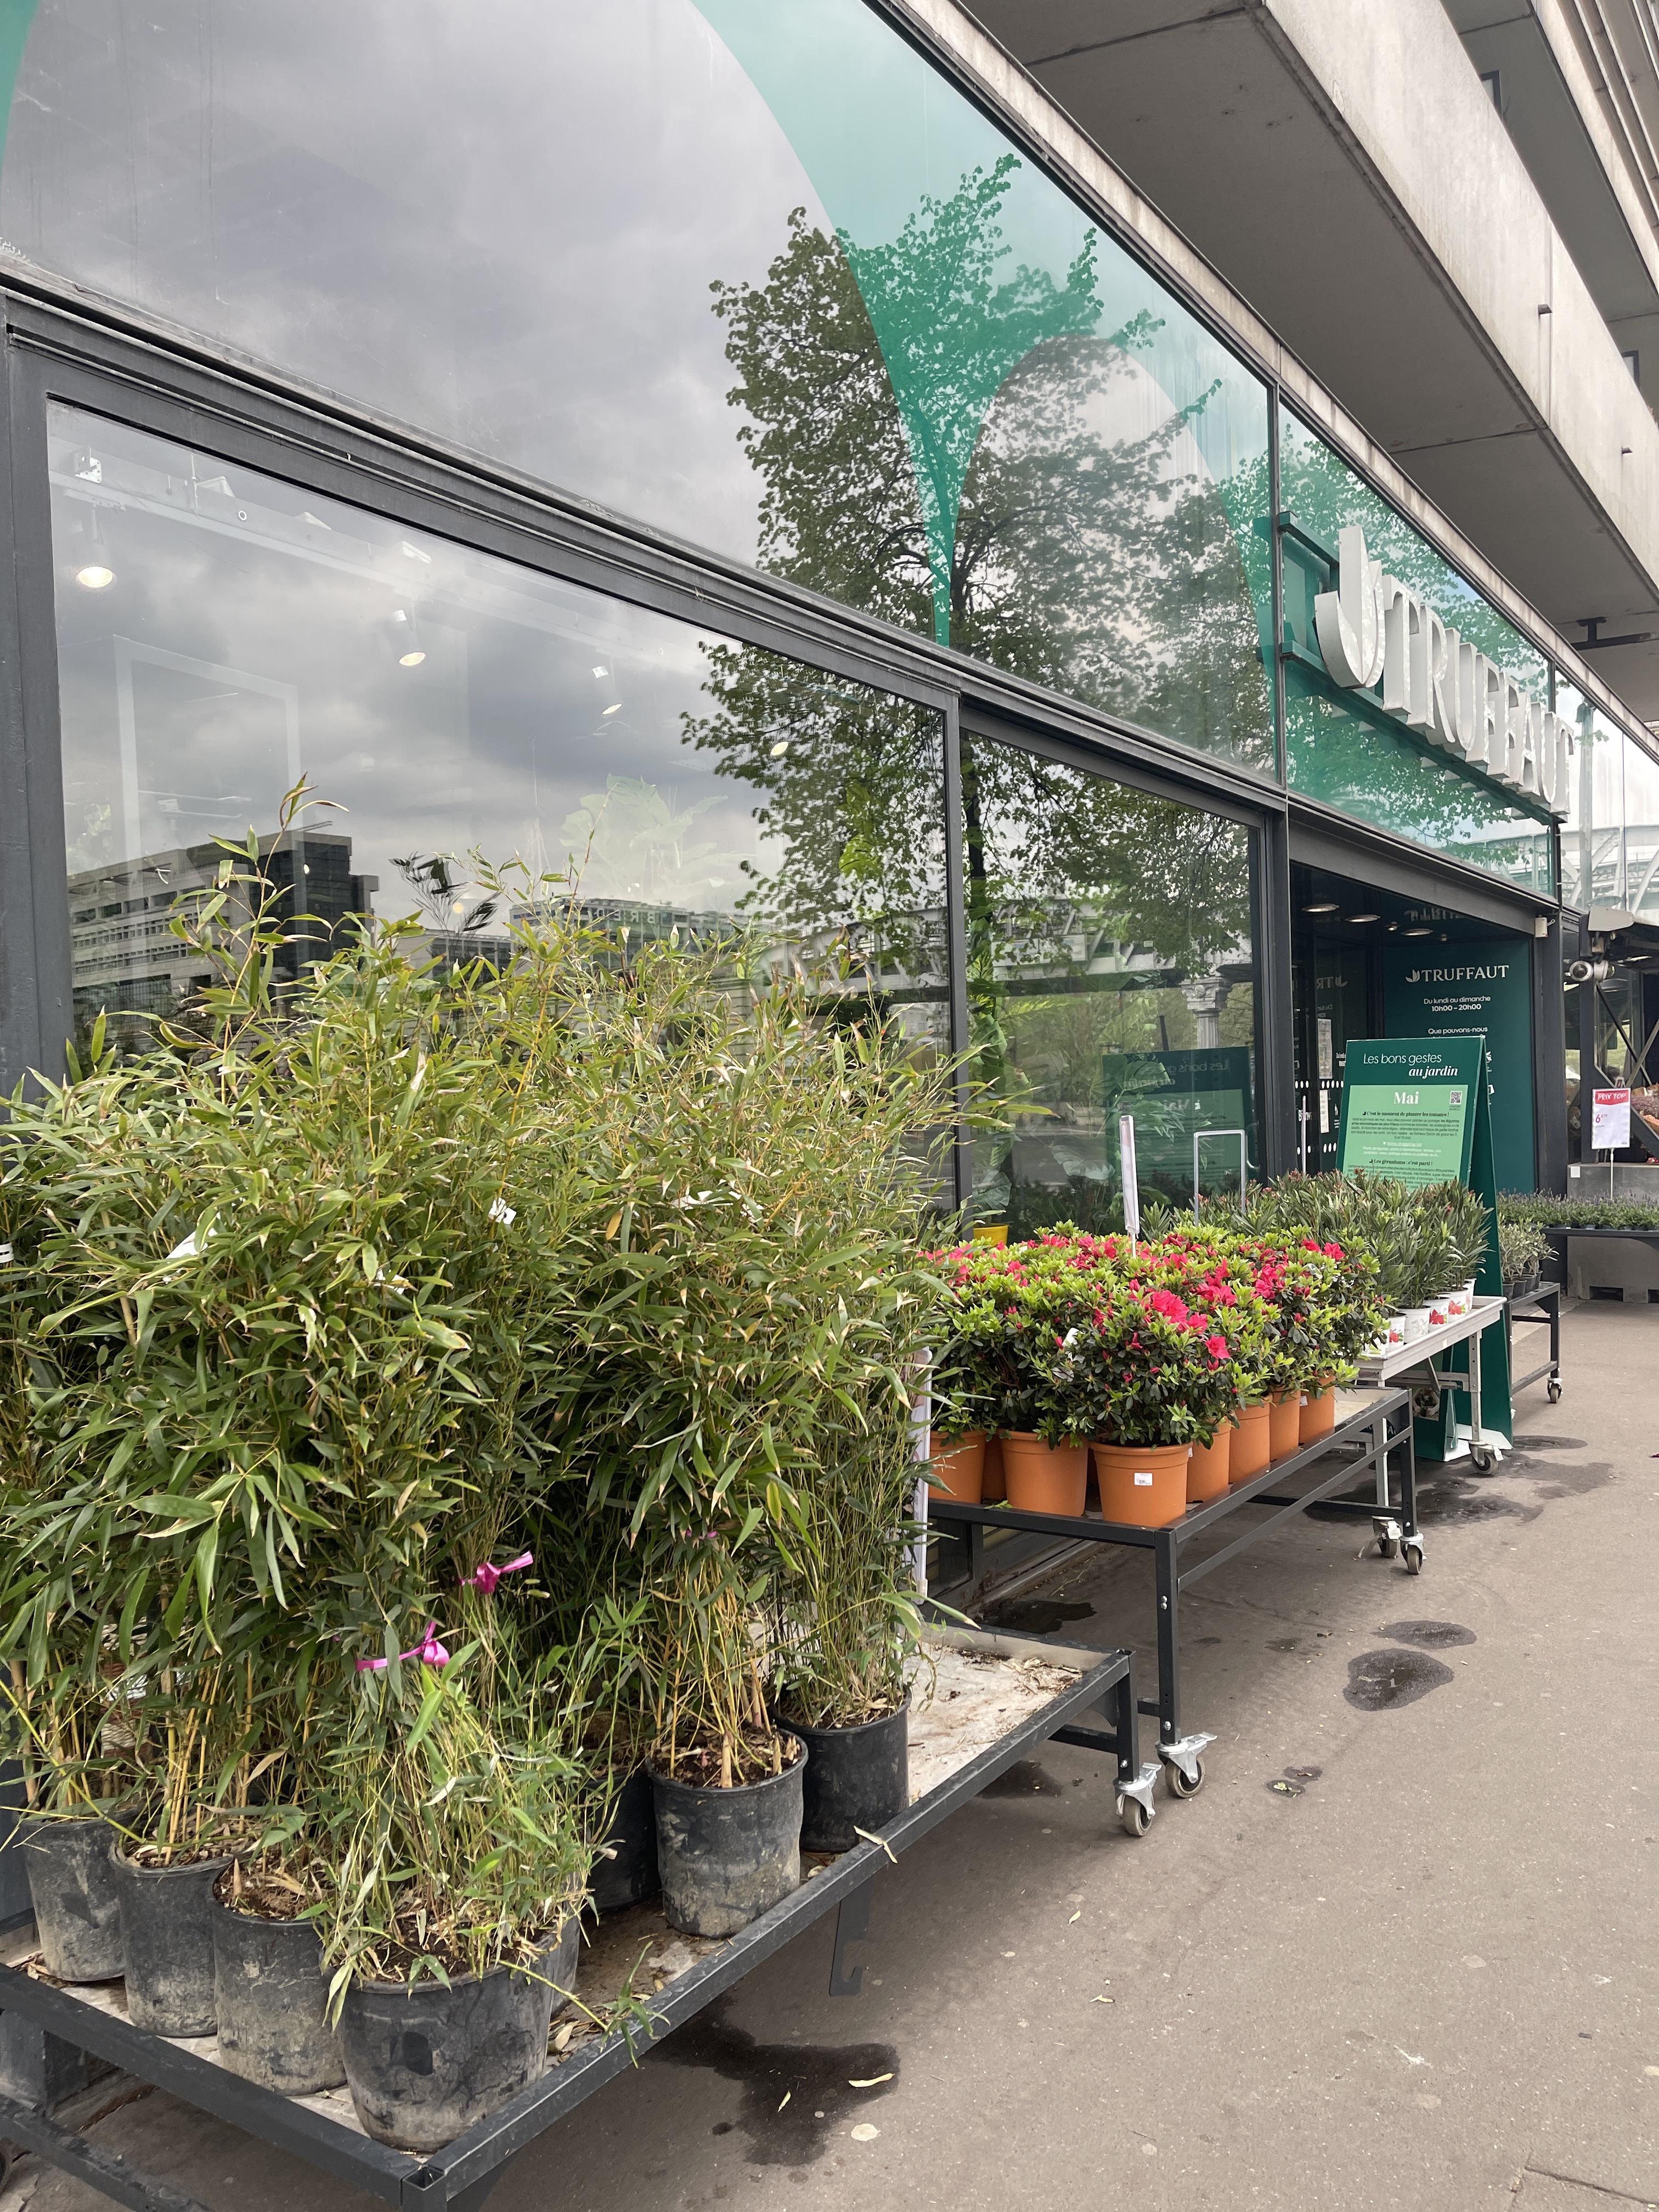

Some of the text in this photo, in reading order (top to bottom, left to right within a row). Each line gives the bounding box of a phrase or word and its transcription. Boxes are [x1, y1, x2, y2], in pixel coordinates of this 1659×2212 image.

[1381, 574, 1575, 815] TRUFFAUT
[1421, 965, 1509, 982] TRUFFAUT
[1443, 1026, 1488, 1035] pouvons-nous
[1363, 1052, 1442, 1066] Les bons gestes
[1408, 1065, 1458, 1079] au jardin
[1393, 1091, 1419, 1104] Mai
